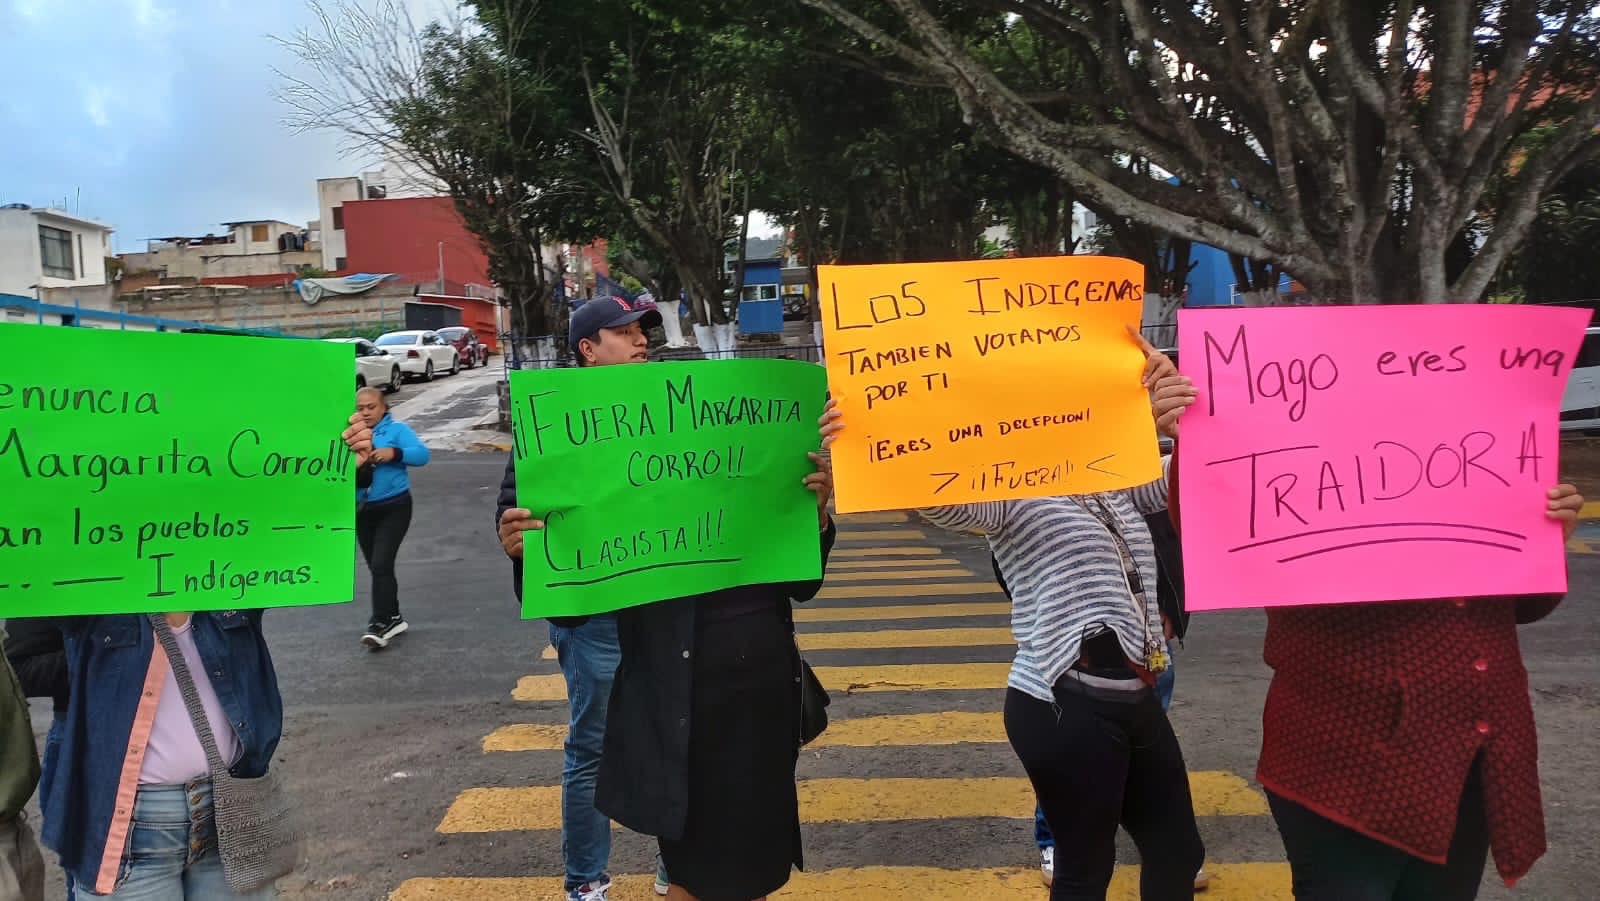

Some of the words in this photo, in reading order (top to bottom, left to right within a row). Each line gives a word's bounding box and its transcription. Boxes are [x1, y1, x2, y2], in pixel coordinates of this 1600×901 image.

[831, 281, 926, 331] LOS
[963, 277, 1143, 315] INDIGENAS
[838, 341, 953, 376] TAMBIEN
[973, 324, 1081, 357] VOTAMOS
[1203, 324, 1339, 423] Mago
[1376, 345, 1467, 377] eres
[1499, 346, 1565, 377] una
[665, 374, 801, 433] MARGARITA
[864, 380, 909, 411] POR
[920, 372, 949, 392] TI
[227, 428, 350, 482] Corro!!!
[627, 444, 745, 488] CORRO!!
[866, 435, 932, 464] ¡ERES
[948, 423, 984, 443] UNA
[1205, 421, 1544, 538] TRAIDORA
[73, 507, 124, 545] los
[136, 511, 249, 559] pueblos
[146, 552, 320, 600] Indígenas.
